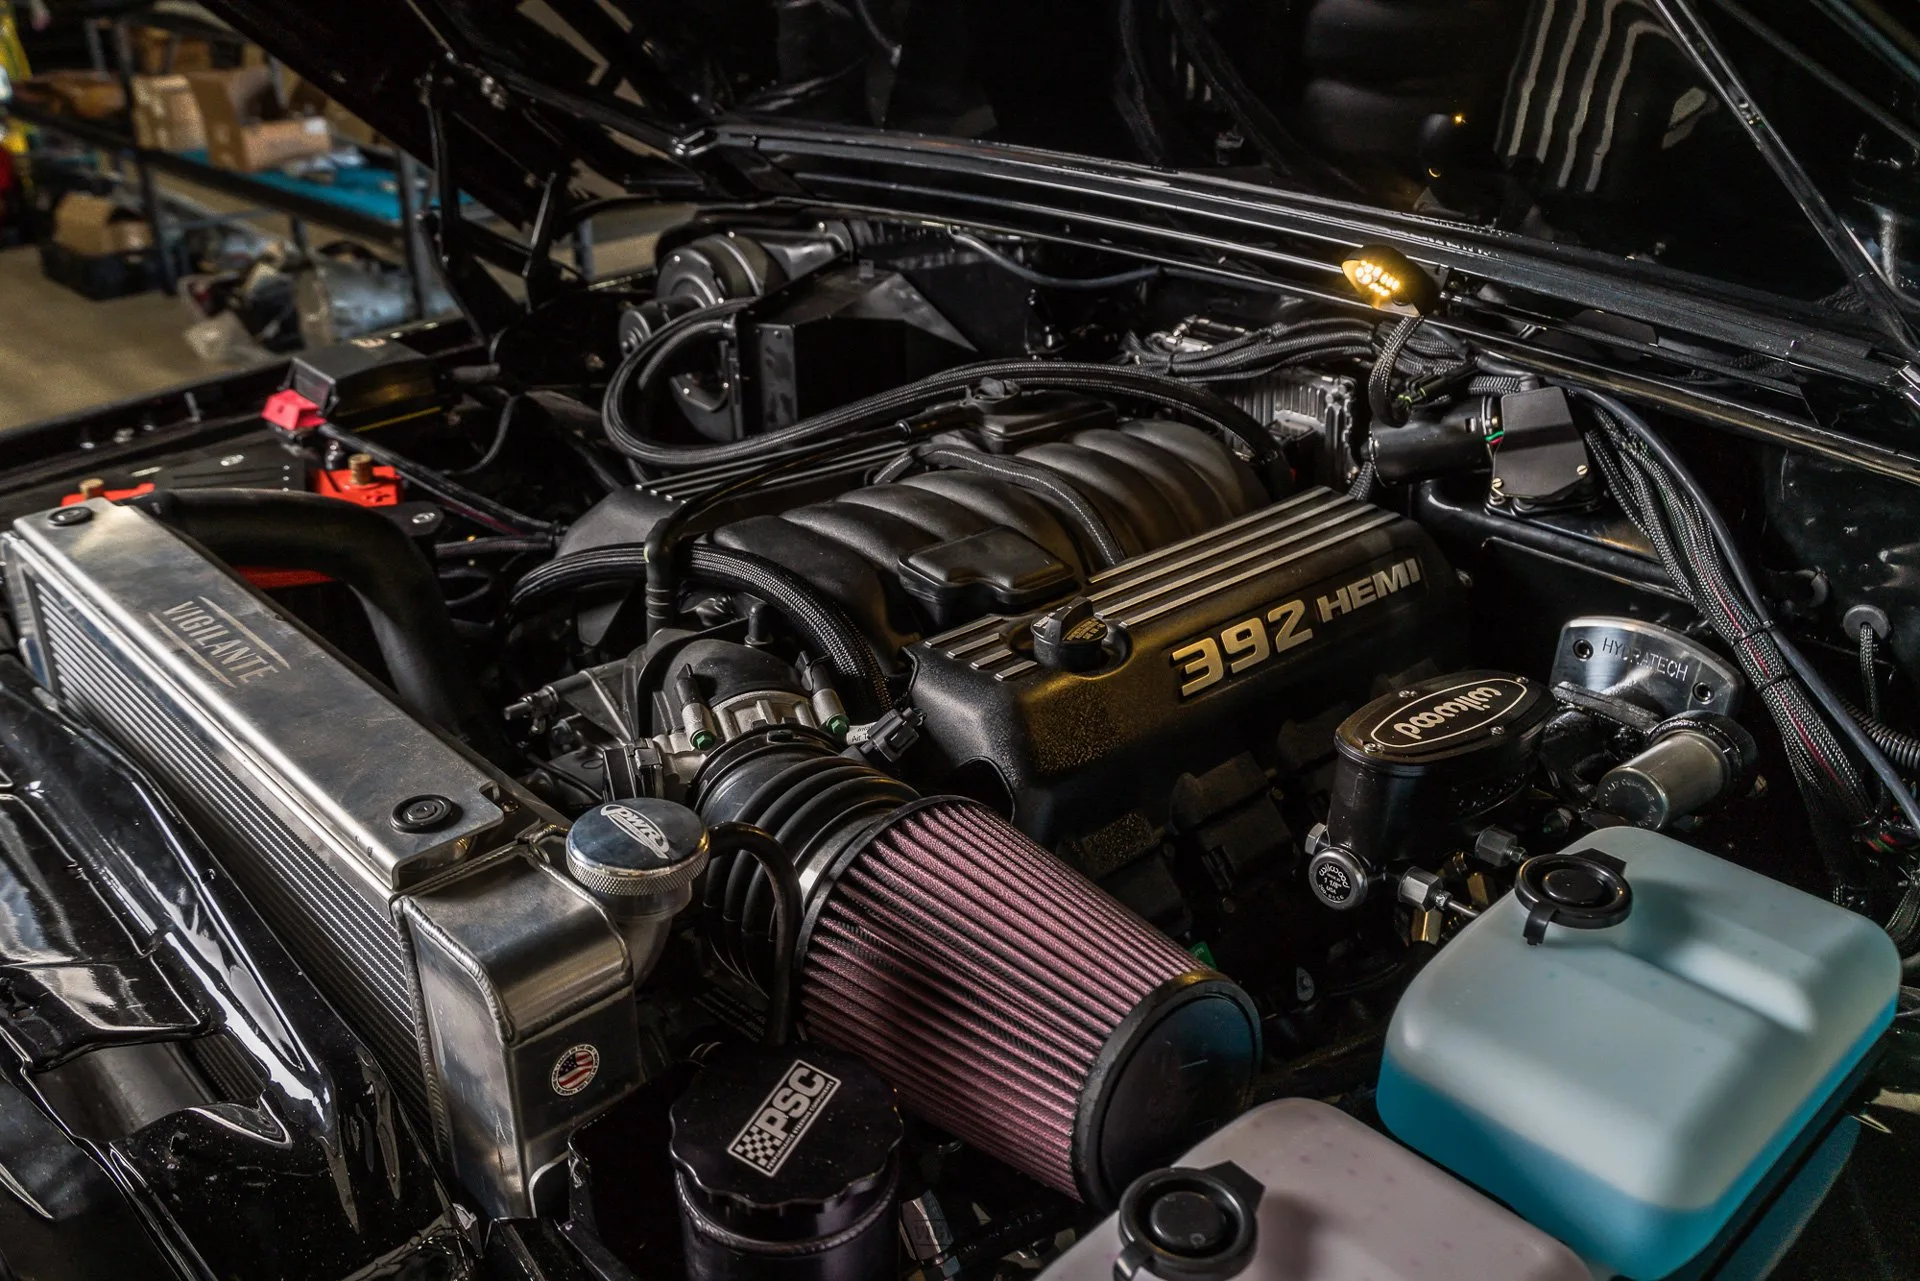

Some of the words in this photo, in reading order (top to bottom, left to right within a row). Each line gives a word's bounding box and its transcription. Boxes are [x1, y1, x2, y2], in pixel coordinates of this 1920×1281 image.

[163, 600, 279, 684] VIGILANTE
[1171, 599, 1314, 697] 392
[1316, 557, 1421, 624] HEMI
[1602, 637, 1689, 682] HYDRATECH
[1393, 686, 1502, 740] wilwood
[602, 805, 669, 854] PWR
[1318, 863, 1350, 888] wilwood
[753, 1066, 826, 1141] PSC
